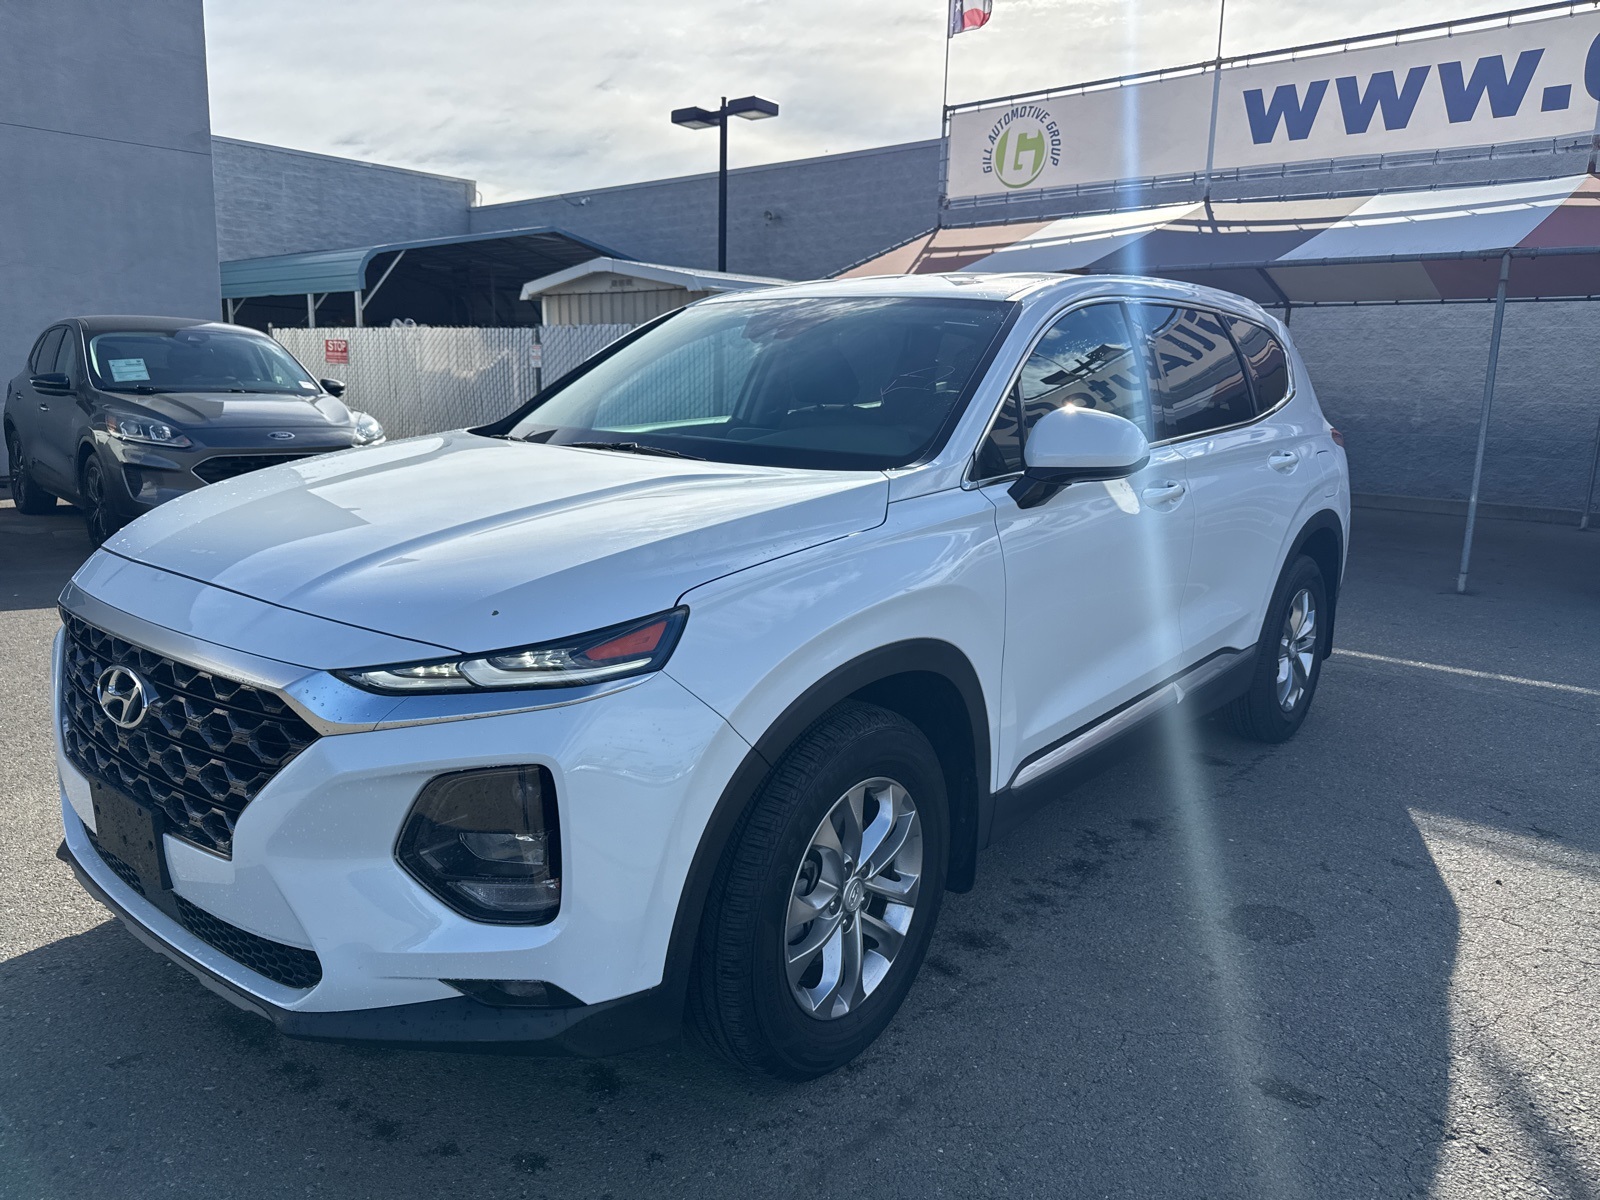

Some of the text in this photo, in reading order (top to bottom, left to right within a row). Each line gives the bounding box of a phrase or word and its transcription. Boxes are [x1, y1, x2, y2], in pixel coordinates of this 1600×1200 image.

[1242, 32, 1600, 145] www.
[982, 105, 1062, 174] GILL AUTOMOTIVE GROUP
[327, 340, 347, 352] STOP
